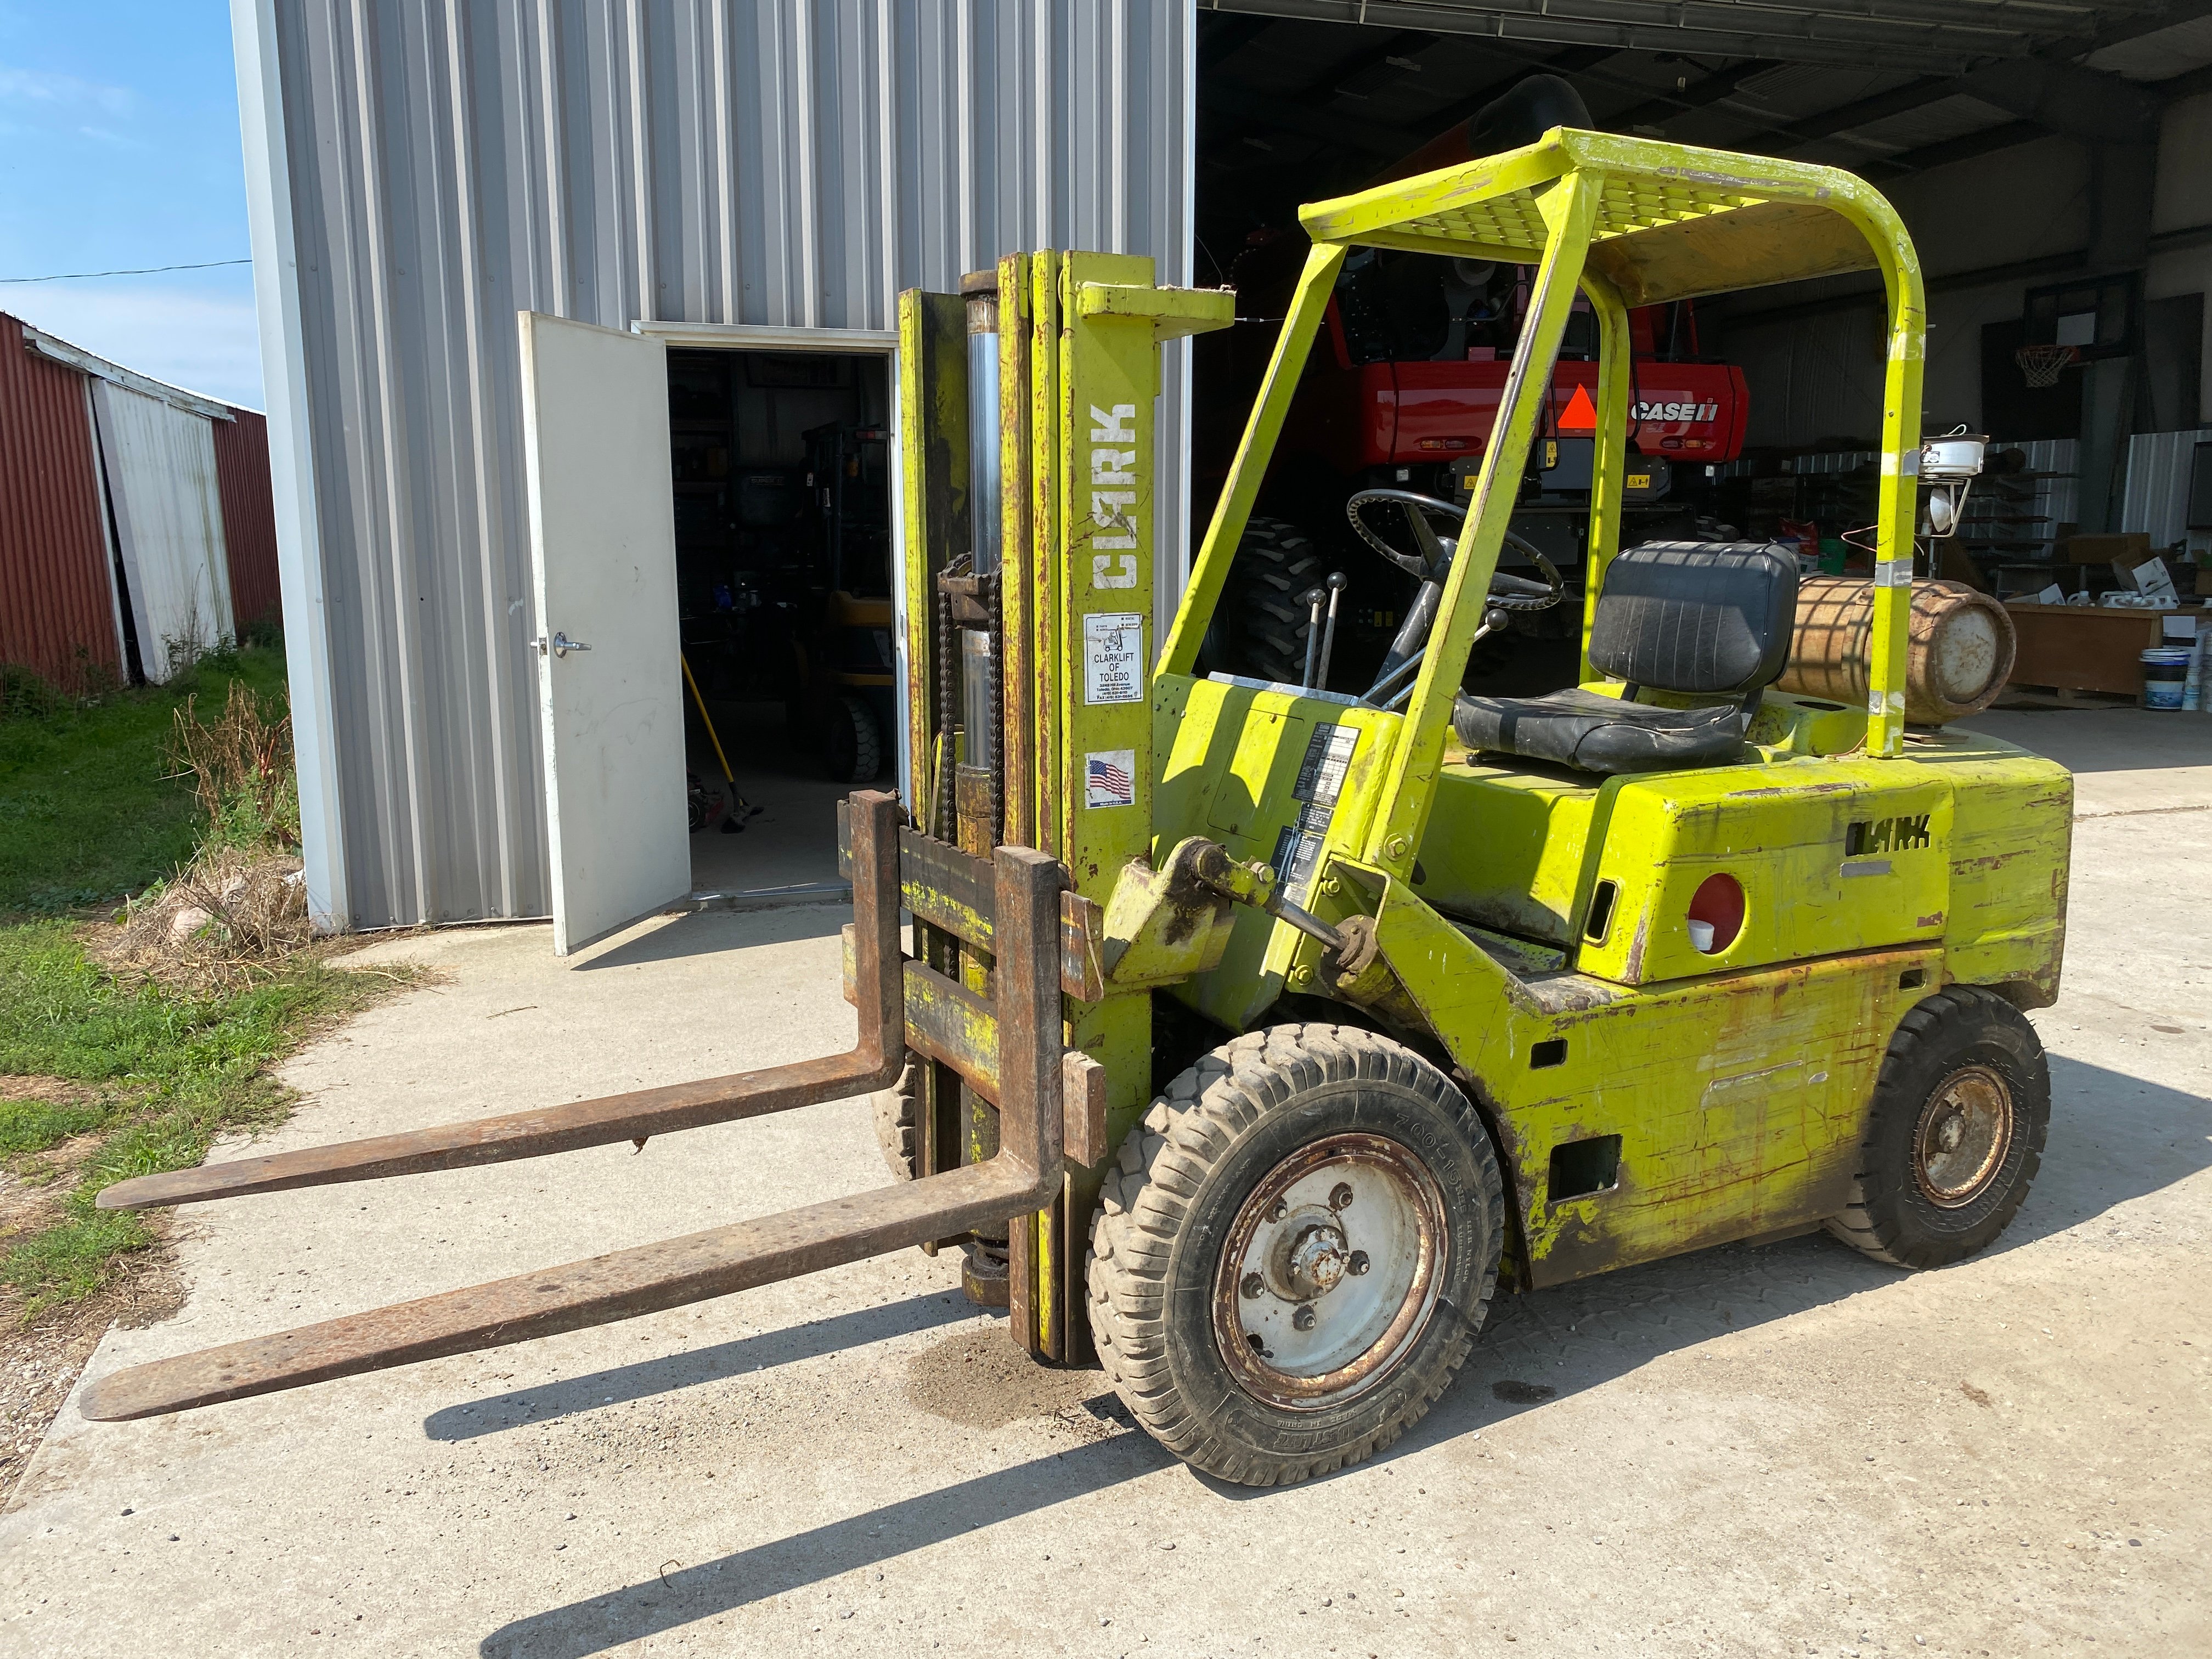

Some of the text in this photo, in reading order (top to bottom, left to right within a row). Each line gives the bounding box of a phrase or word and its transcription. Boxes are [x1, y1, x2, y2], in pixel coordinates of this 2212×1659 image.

[1630, 401, 1696, 421] CASE
[1090, 403, 1137, 590] CLARK
[1094, 652, 1134, 663] CLARKLIFT
[1109, 663, 1120, 672] OF
[1099, 672, 1129, 682] TOLEDO
[1845, 814, 1931, 857] ARK
[1272, 1423, 1355, 1451] WESTLAKE
